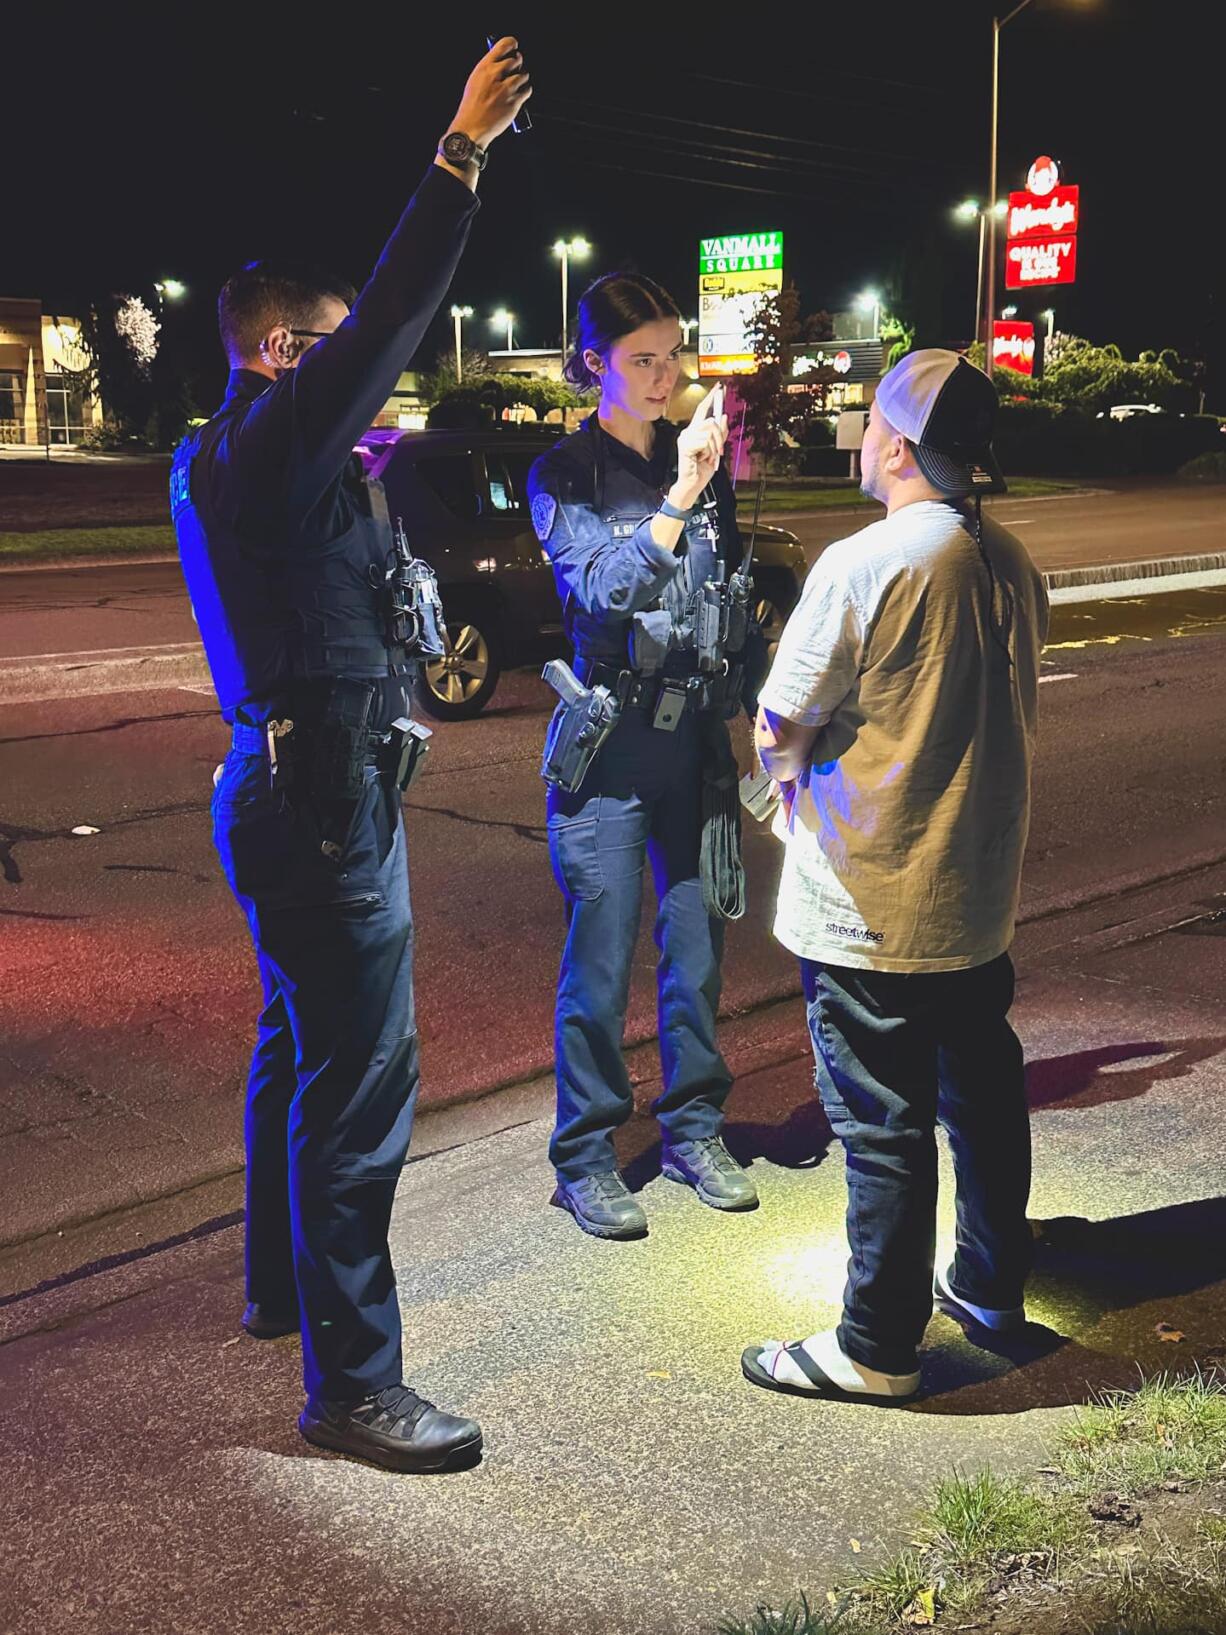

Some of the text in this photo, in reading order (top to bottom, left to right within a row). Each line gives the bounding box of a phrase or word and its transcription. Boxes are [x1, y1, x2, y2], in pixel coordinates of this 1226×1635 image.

[702, 232, 781, 256] VANMALL
[1009, 242, 1072, 262] QUALITY
[706, 254, 774, 273] SQUARE
[825, 922, 885, 942] streetwise
